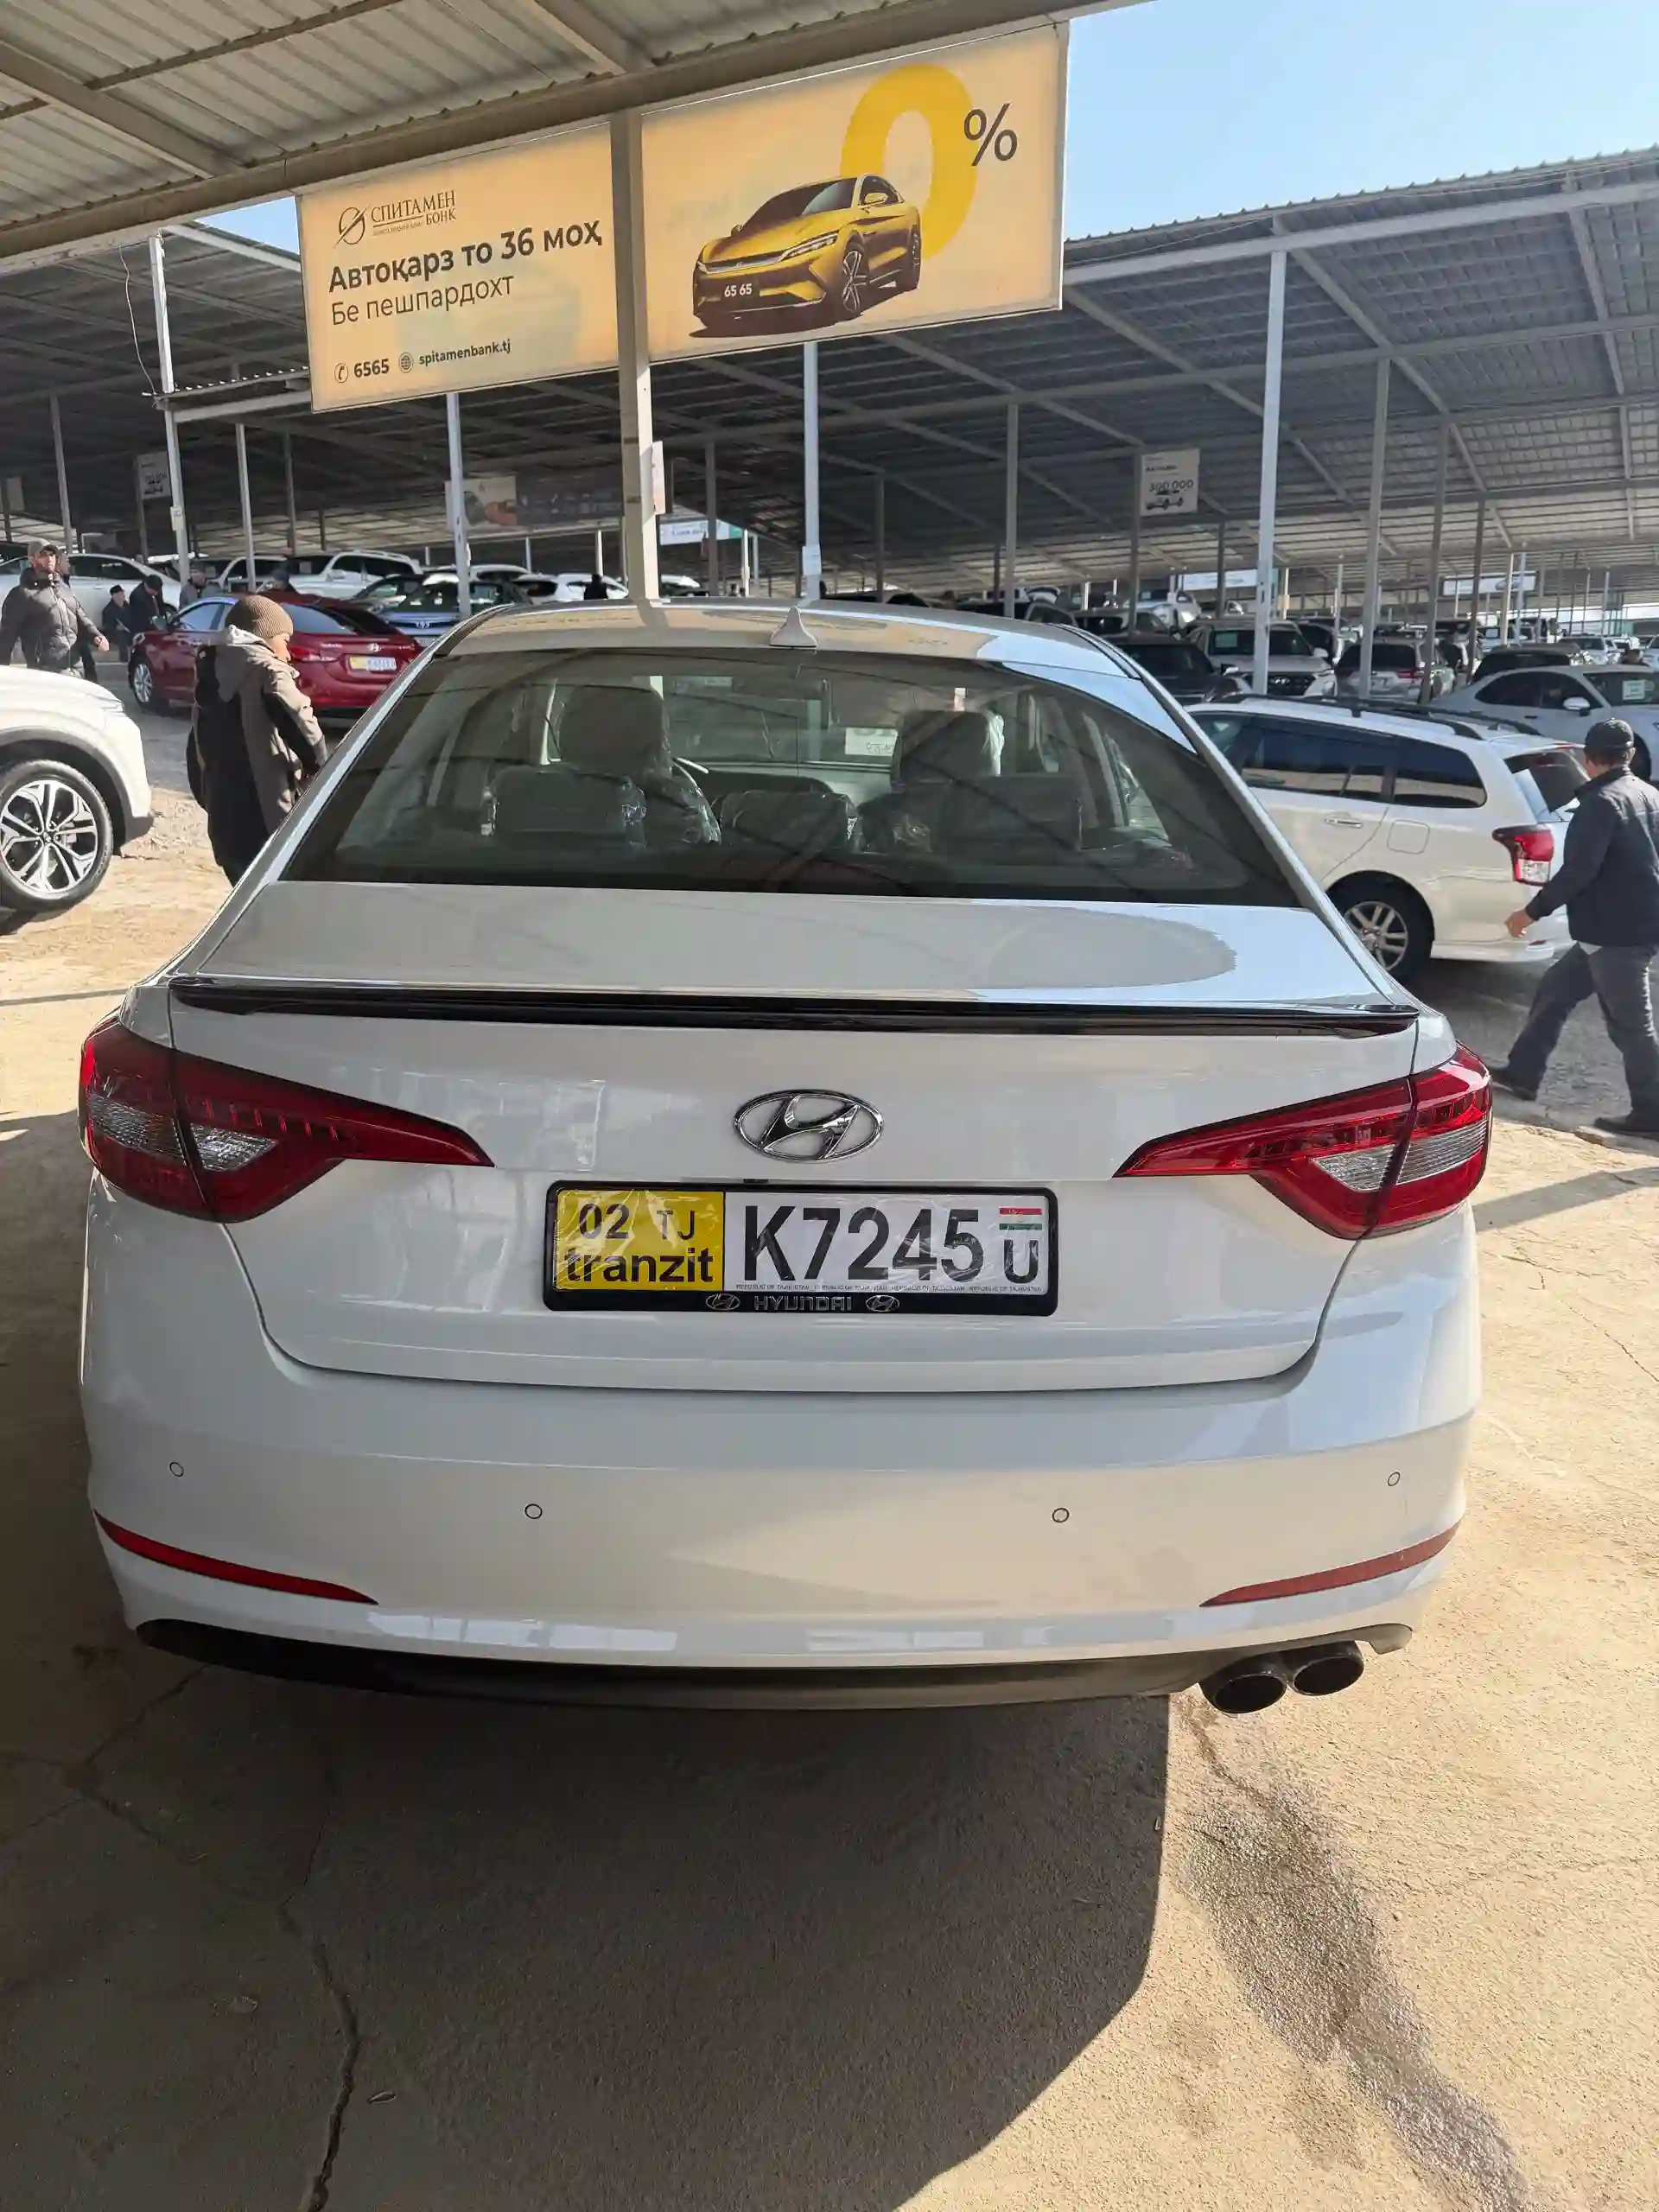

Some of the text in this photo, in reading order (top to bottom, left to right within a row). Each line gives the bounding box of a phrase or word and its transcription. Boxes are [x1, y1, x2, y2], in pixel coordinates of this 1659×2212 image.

[371, 189, 456, 223] СПИТАМЕН
[426, 207, 457, 226] БОНК
[328, 219, 602, 293] Автоқарз то 36 моҳ
[332, 276, 515, 326] Бе пешпардохт
[723, 283, 753, 297] 65 65
[353, 338, 512, 378] 6565 spitamenbank.tj
[579, 1203, 696, 1242] 02 TJ
[744, 1205, 1040, 1285] K7245 U
[563, 1247, 715, 1283] tranzit
[753, 1295, 853, 1312] HYUNDAI
